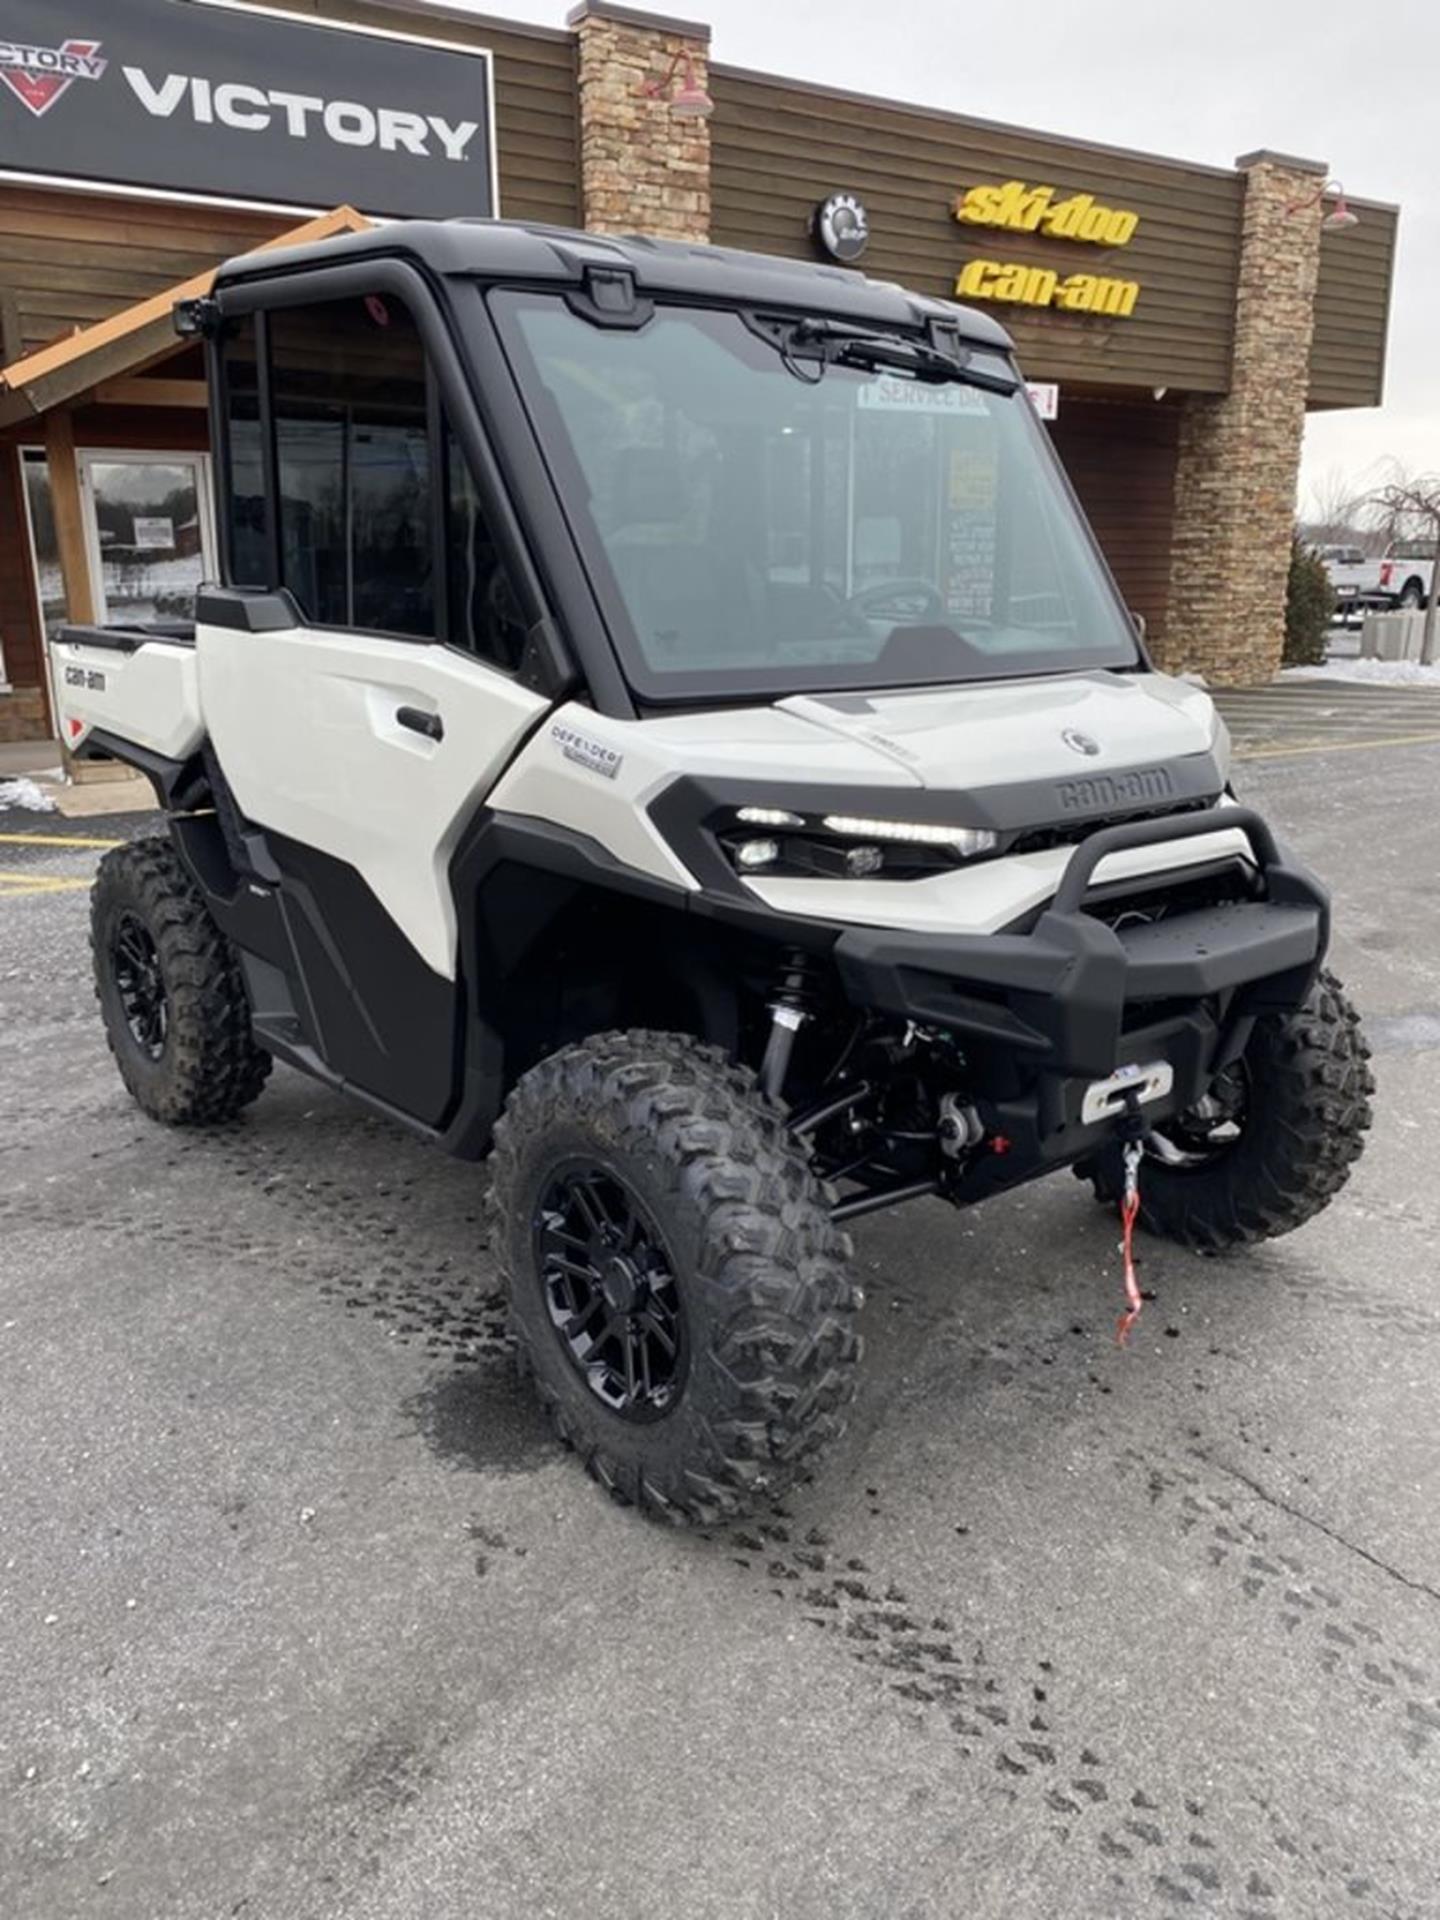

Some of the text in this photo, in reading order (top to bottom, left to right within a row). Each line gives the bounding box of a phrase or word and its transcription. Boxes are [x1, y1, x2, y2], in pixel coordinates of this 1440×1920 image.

[0, 43, 100, 76] CTORY
[121, 66, 479, 161] VICTORY
[956, 180, 1139, 246] ski-doo
[956, 259, 1139, 316] can-am
[65, 665, 106, 692] can-am
[551, 725, 617, 762] DEFENDER
[1055, 767, 1173, 809] can-am
